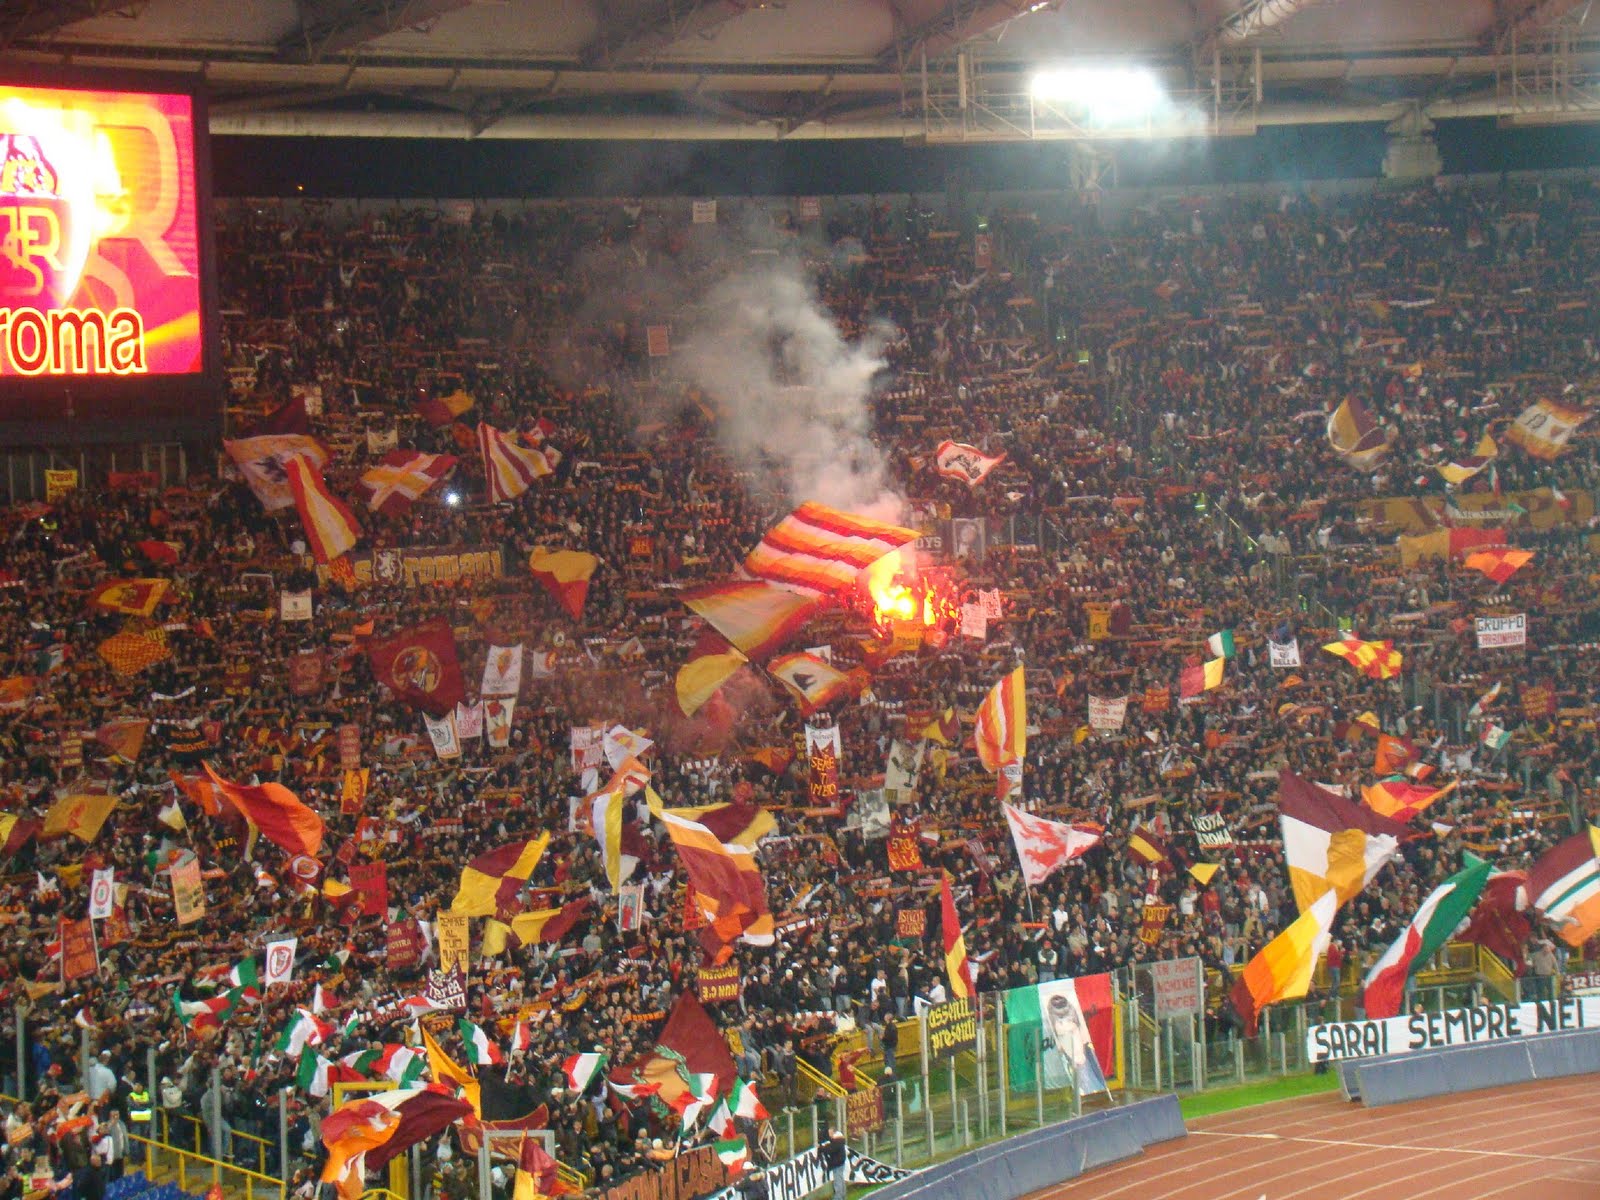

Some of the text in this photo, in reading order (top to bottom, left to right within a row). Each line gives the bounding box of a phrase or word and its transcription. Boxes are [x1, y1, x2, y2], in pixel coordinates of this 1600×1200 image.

[931, 1018, 977, 1057] presenti
[1315, 998, 1584, 1060] SARAI SEMPRE NEI
